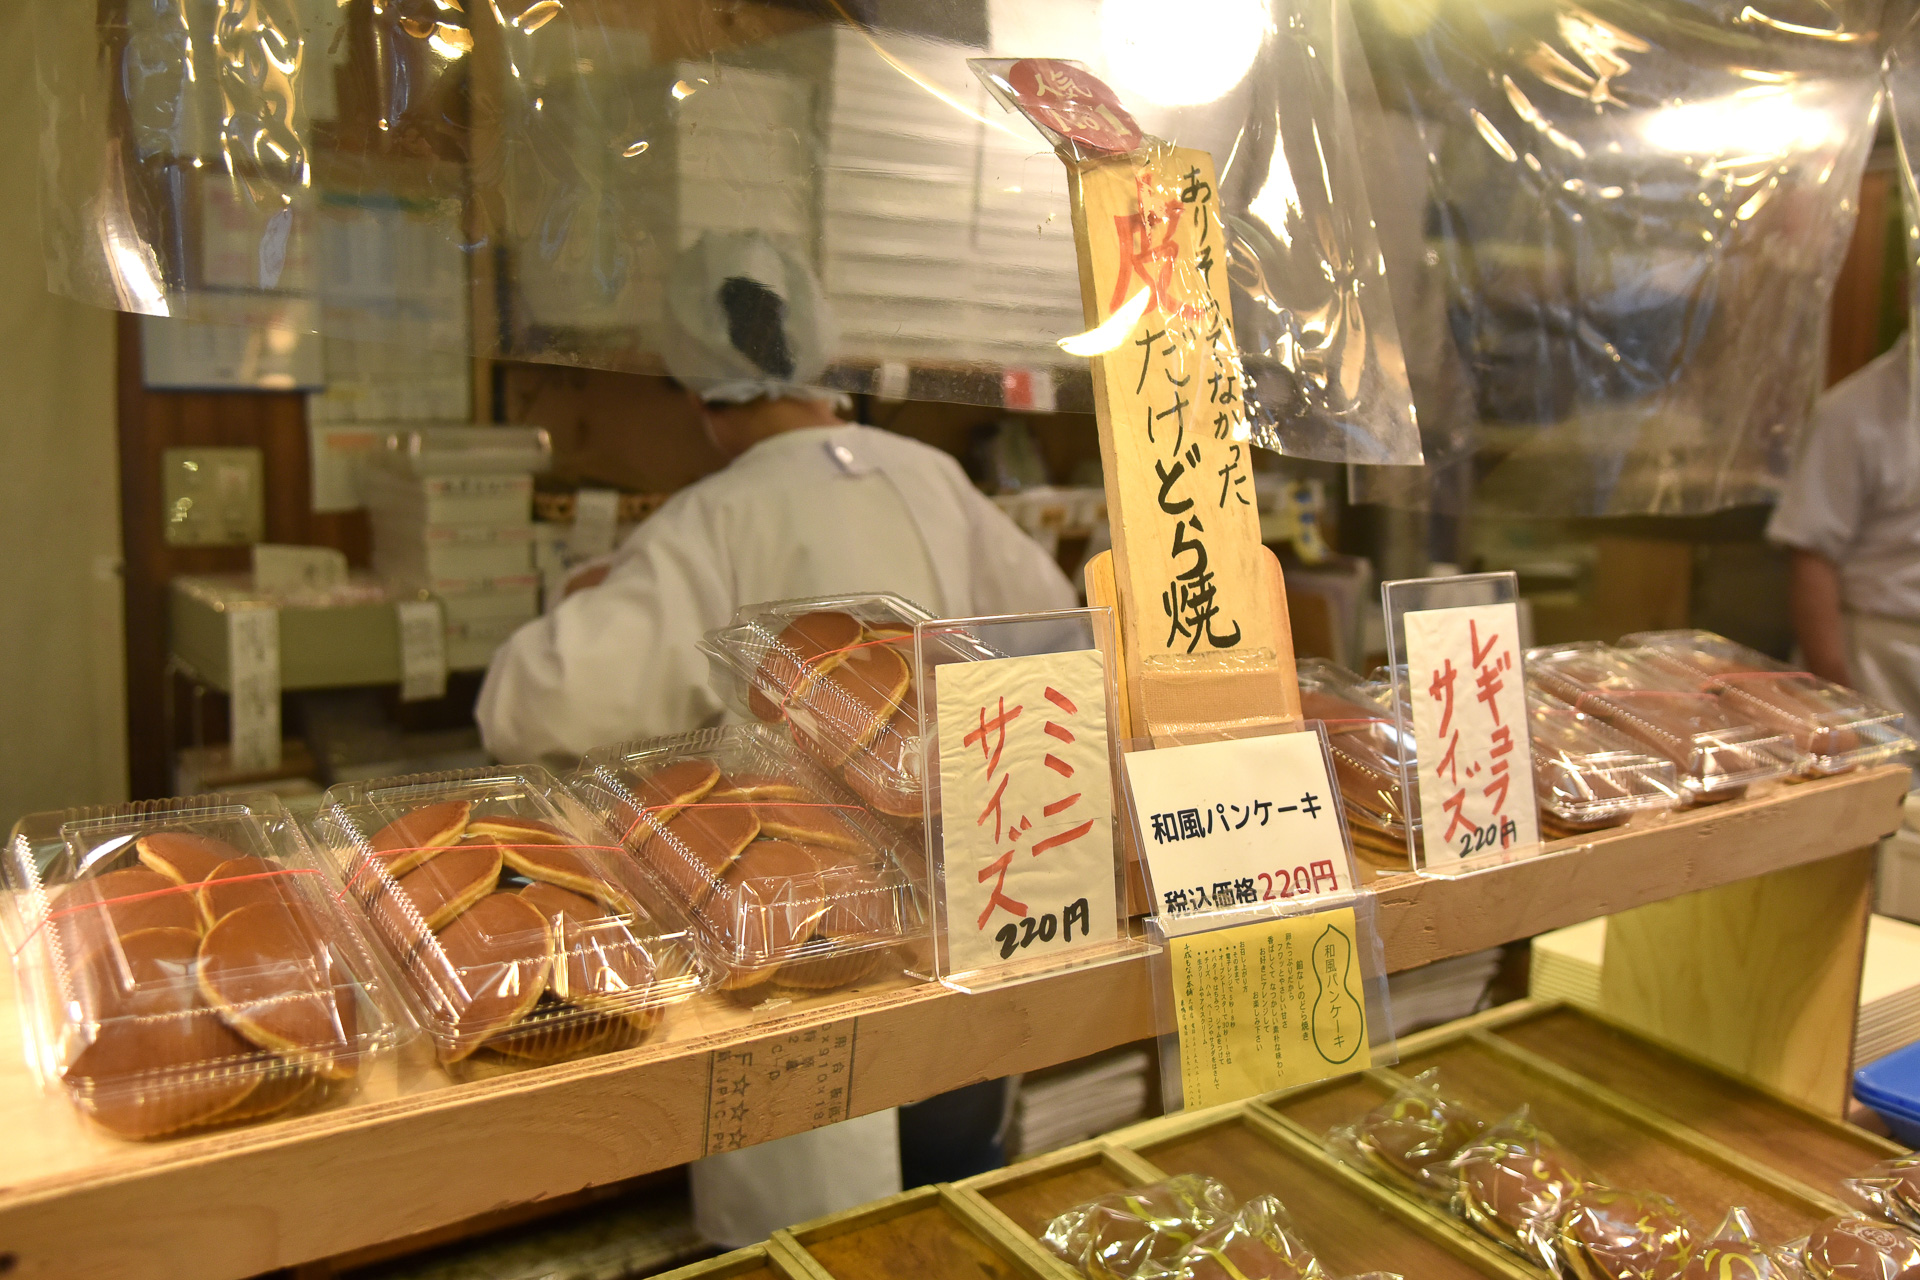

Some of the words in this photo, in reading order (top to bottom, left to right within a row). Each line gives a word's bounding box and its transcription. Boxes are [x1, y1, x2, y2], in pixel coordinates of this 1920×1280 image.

[1031, 686, 1094, 857] ミニ
[1429, 659, 1481, 843] サイズ
[963, 696, 1032, 930] サイズ
[1150, 792, 1322, 844] 和風パンケーキ
[1460, 820, 1516, 858] 220円
[995, 898, 1089, 959] 220円
[1324, 944, 1345, 1048] 和風パンケーキ
